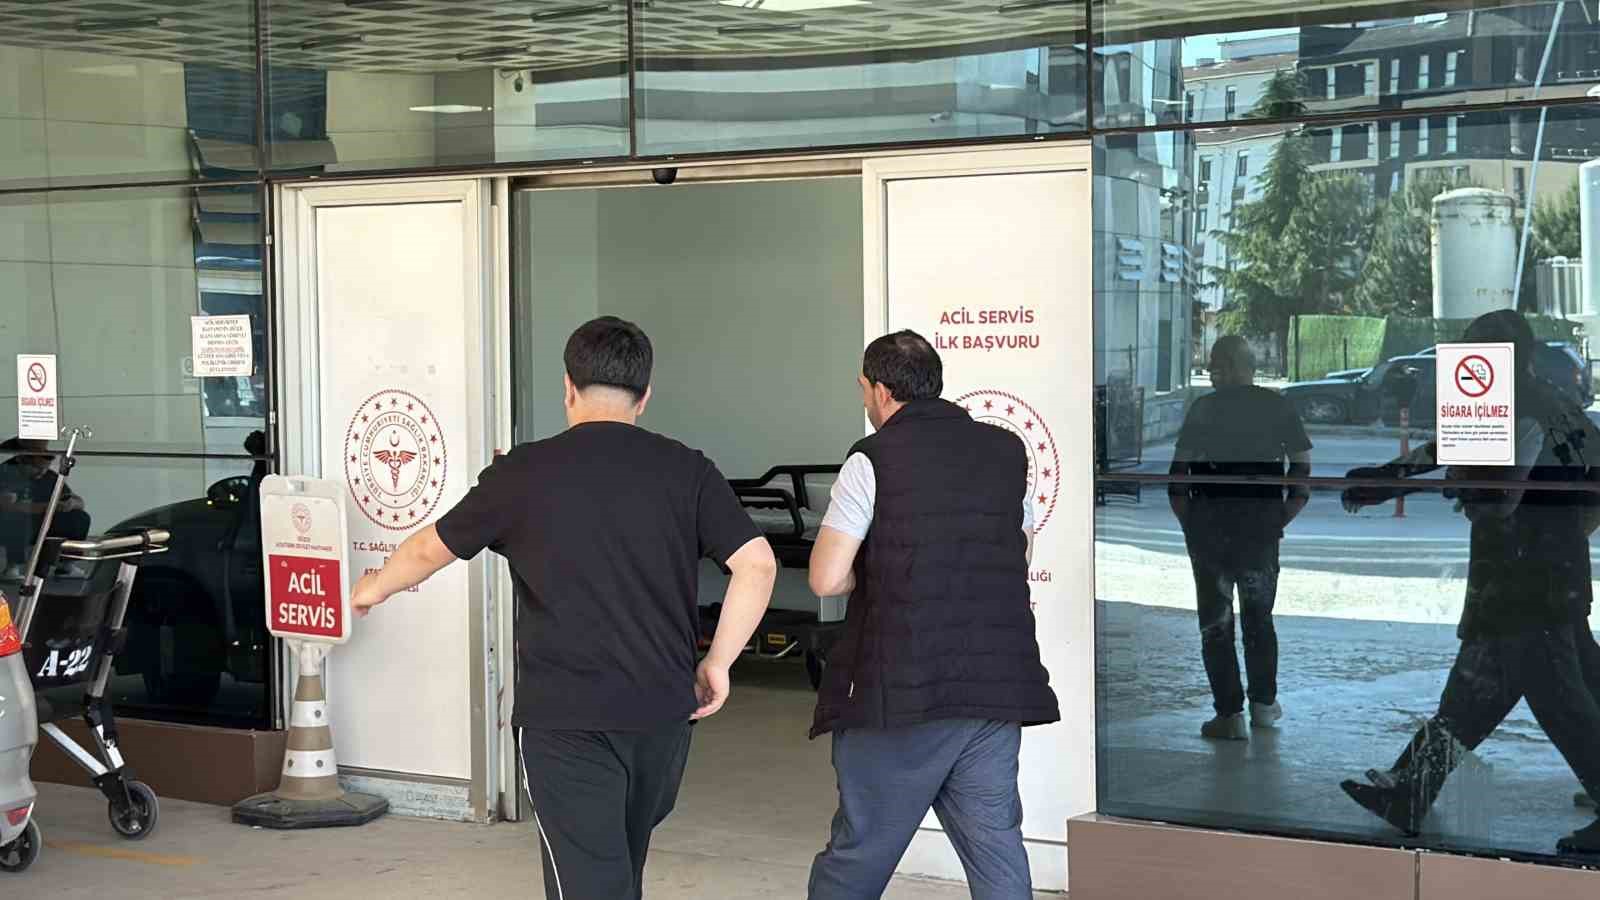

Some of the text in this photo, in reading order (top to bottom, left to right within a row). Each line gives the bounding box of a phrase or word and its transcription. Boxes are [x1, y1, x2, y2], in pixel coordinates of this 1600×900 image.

[940, 305, 1035, 325] ACİL SERVİS
[935, 332, 1040, 352] İLK BAŞVURU
[1440, 402, 1509, 421] SİGARA İÇİLMEZ
[288, 568, 326, 596] ACİL
[279, 602, 336, 629] SERVİS
[37, 645, 92, 677] A-22
